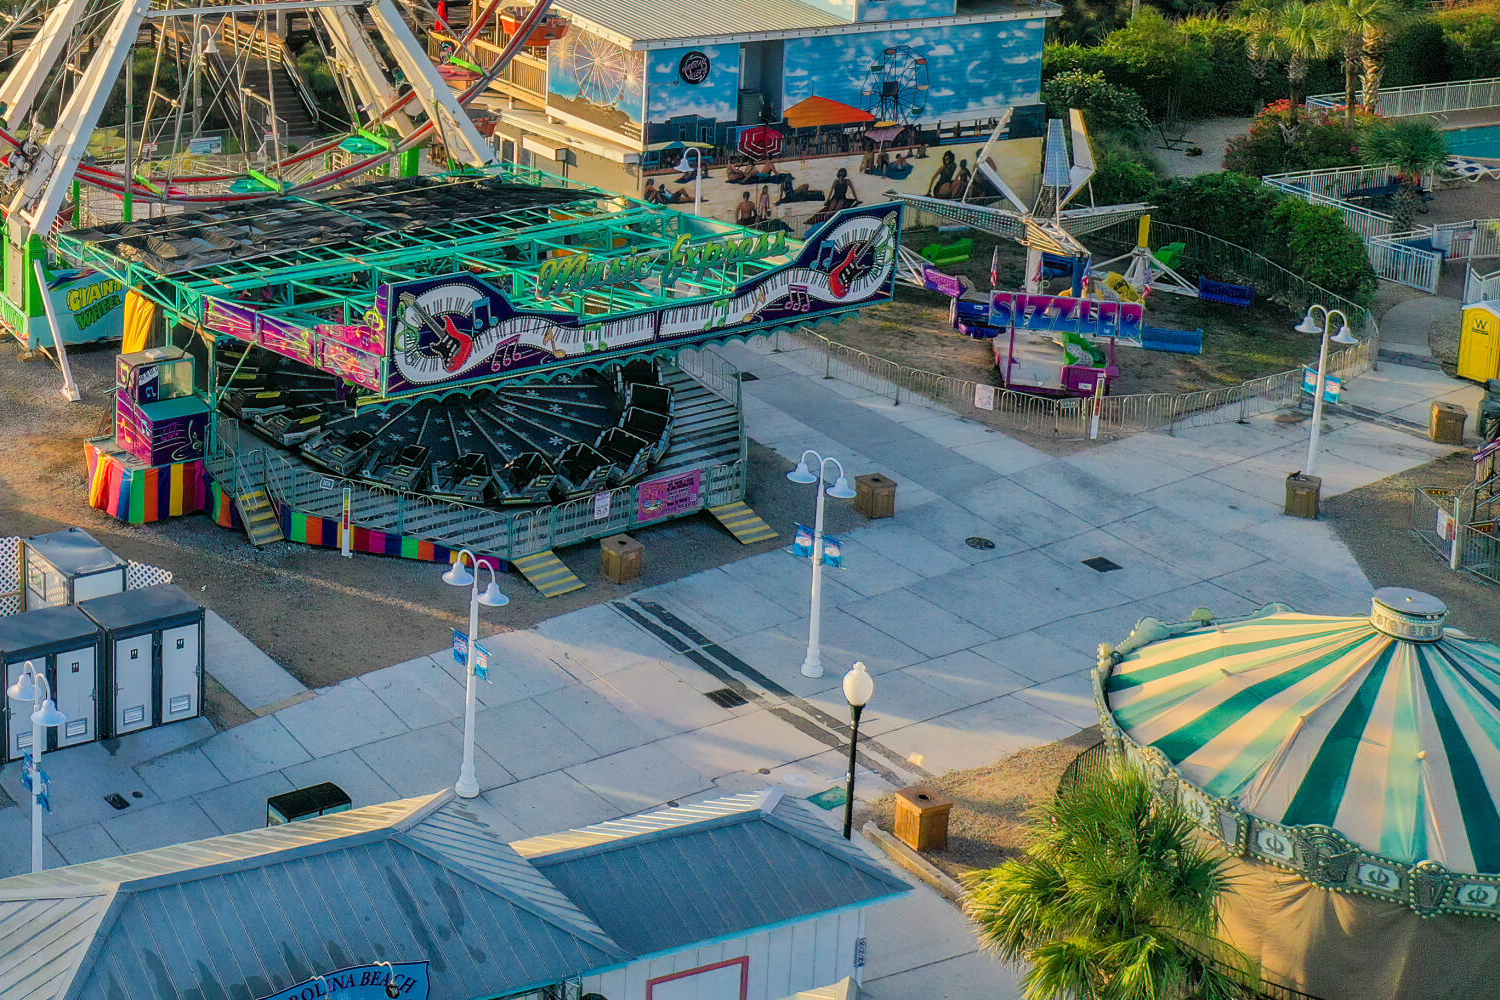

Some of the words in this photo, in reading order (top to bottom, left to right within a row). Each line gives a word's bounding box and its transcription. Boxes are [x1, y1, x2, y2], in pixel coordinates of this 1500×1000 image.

[536, 246, 651, 297] Music
[660, 230, 789, 287] Express
[66, 278, 124, 311] GIANT
[73, 295, 123, 330] WHEEL
[989, 291, 1143, 345] SIZZLER
[359, 970, 419, 995] BEACH
